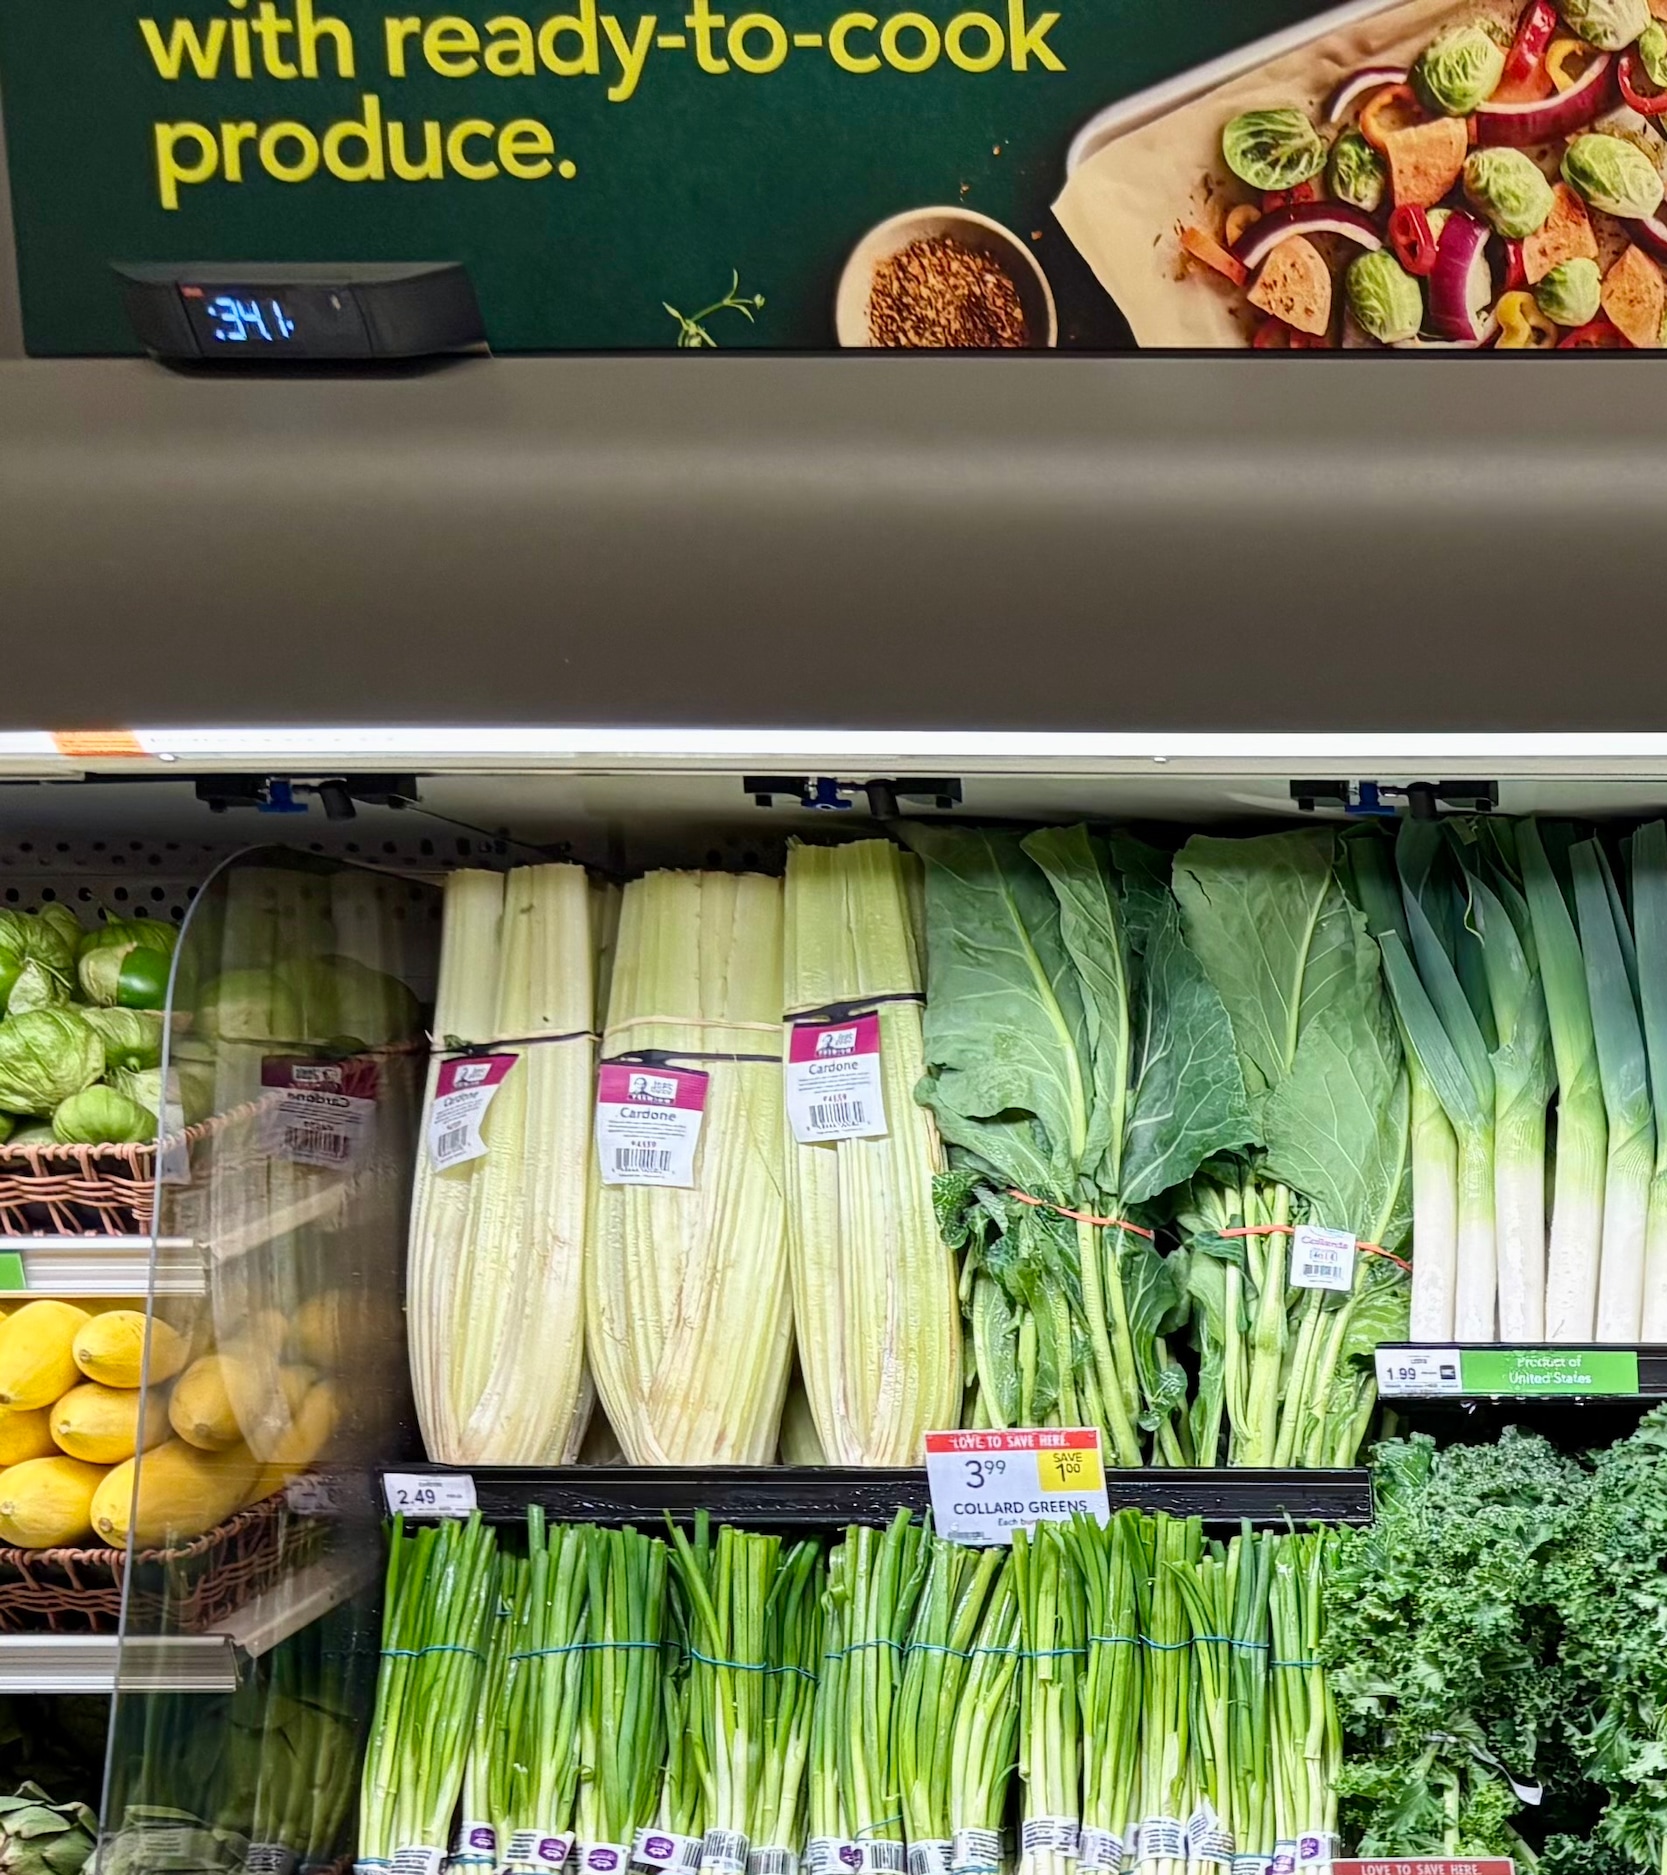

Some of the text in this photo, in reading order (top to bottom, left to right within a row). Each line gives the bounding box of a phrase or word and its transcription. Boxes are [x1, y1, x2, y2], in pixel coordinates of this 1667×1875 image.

[139, 0, 1067, 102] with ready-to-cook
[154, 94, 577, 210] produce.
[808, 1061, 860, 1076] Cardone
[619, 1106, 678, 1123] Cardone
[1386, 1368, 1417, 1381] 1.99
[1508, 1372, 1592, 1385] United States
[986, 1434, 1002, 1448] TO
[1007, 1433, 1035, 1448] SAVE
[1053, 1452, 1083, 1463] SAVE
[396, 1490, 437, 1505] 2.49
[953, 1499, 1088, 1516] COLLARD GREENS
[997, 1517, 1019, 1527] Each
[1395, 1864, 1412, 1875] TO
[1416, 1863, 1445, 1875] SAVE
[1450, 1863, 1483, 1875] HERE.
